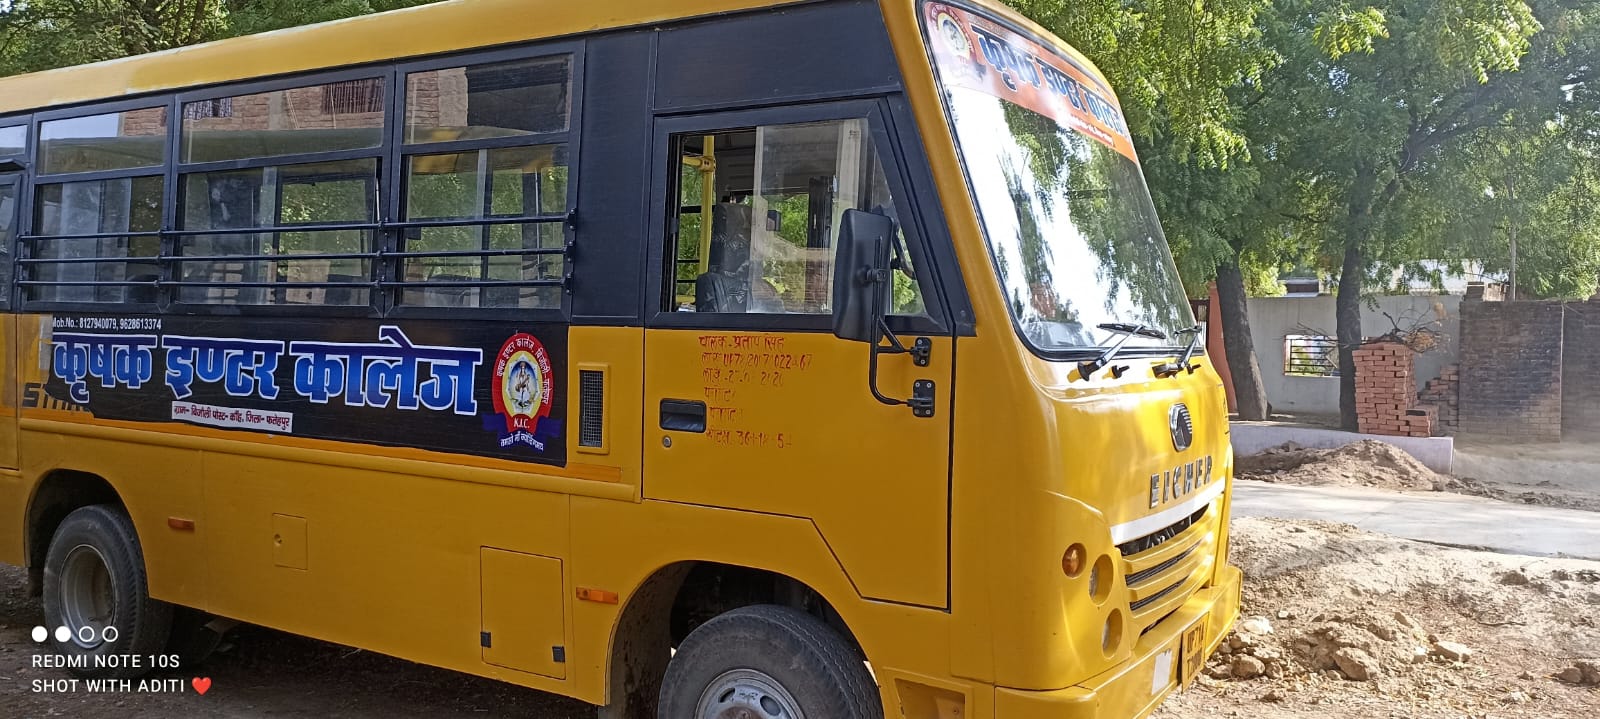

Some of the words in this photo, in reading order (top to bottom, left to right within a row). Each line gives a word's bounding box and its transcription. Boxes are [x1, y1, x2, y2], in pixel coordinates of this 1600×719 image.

[120, 318, 162, 330] 9628613374
[51, 332, 157, 403] कृषक
[162, 335, 285, 399] इण्टर
[289, 325, 483, 416] कालेज
[1149, 455, 1212, 509] EICHER
